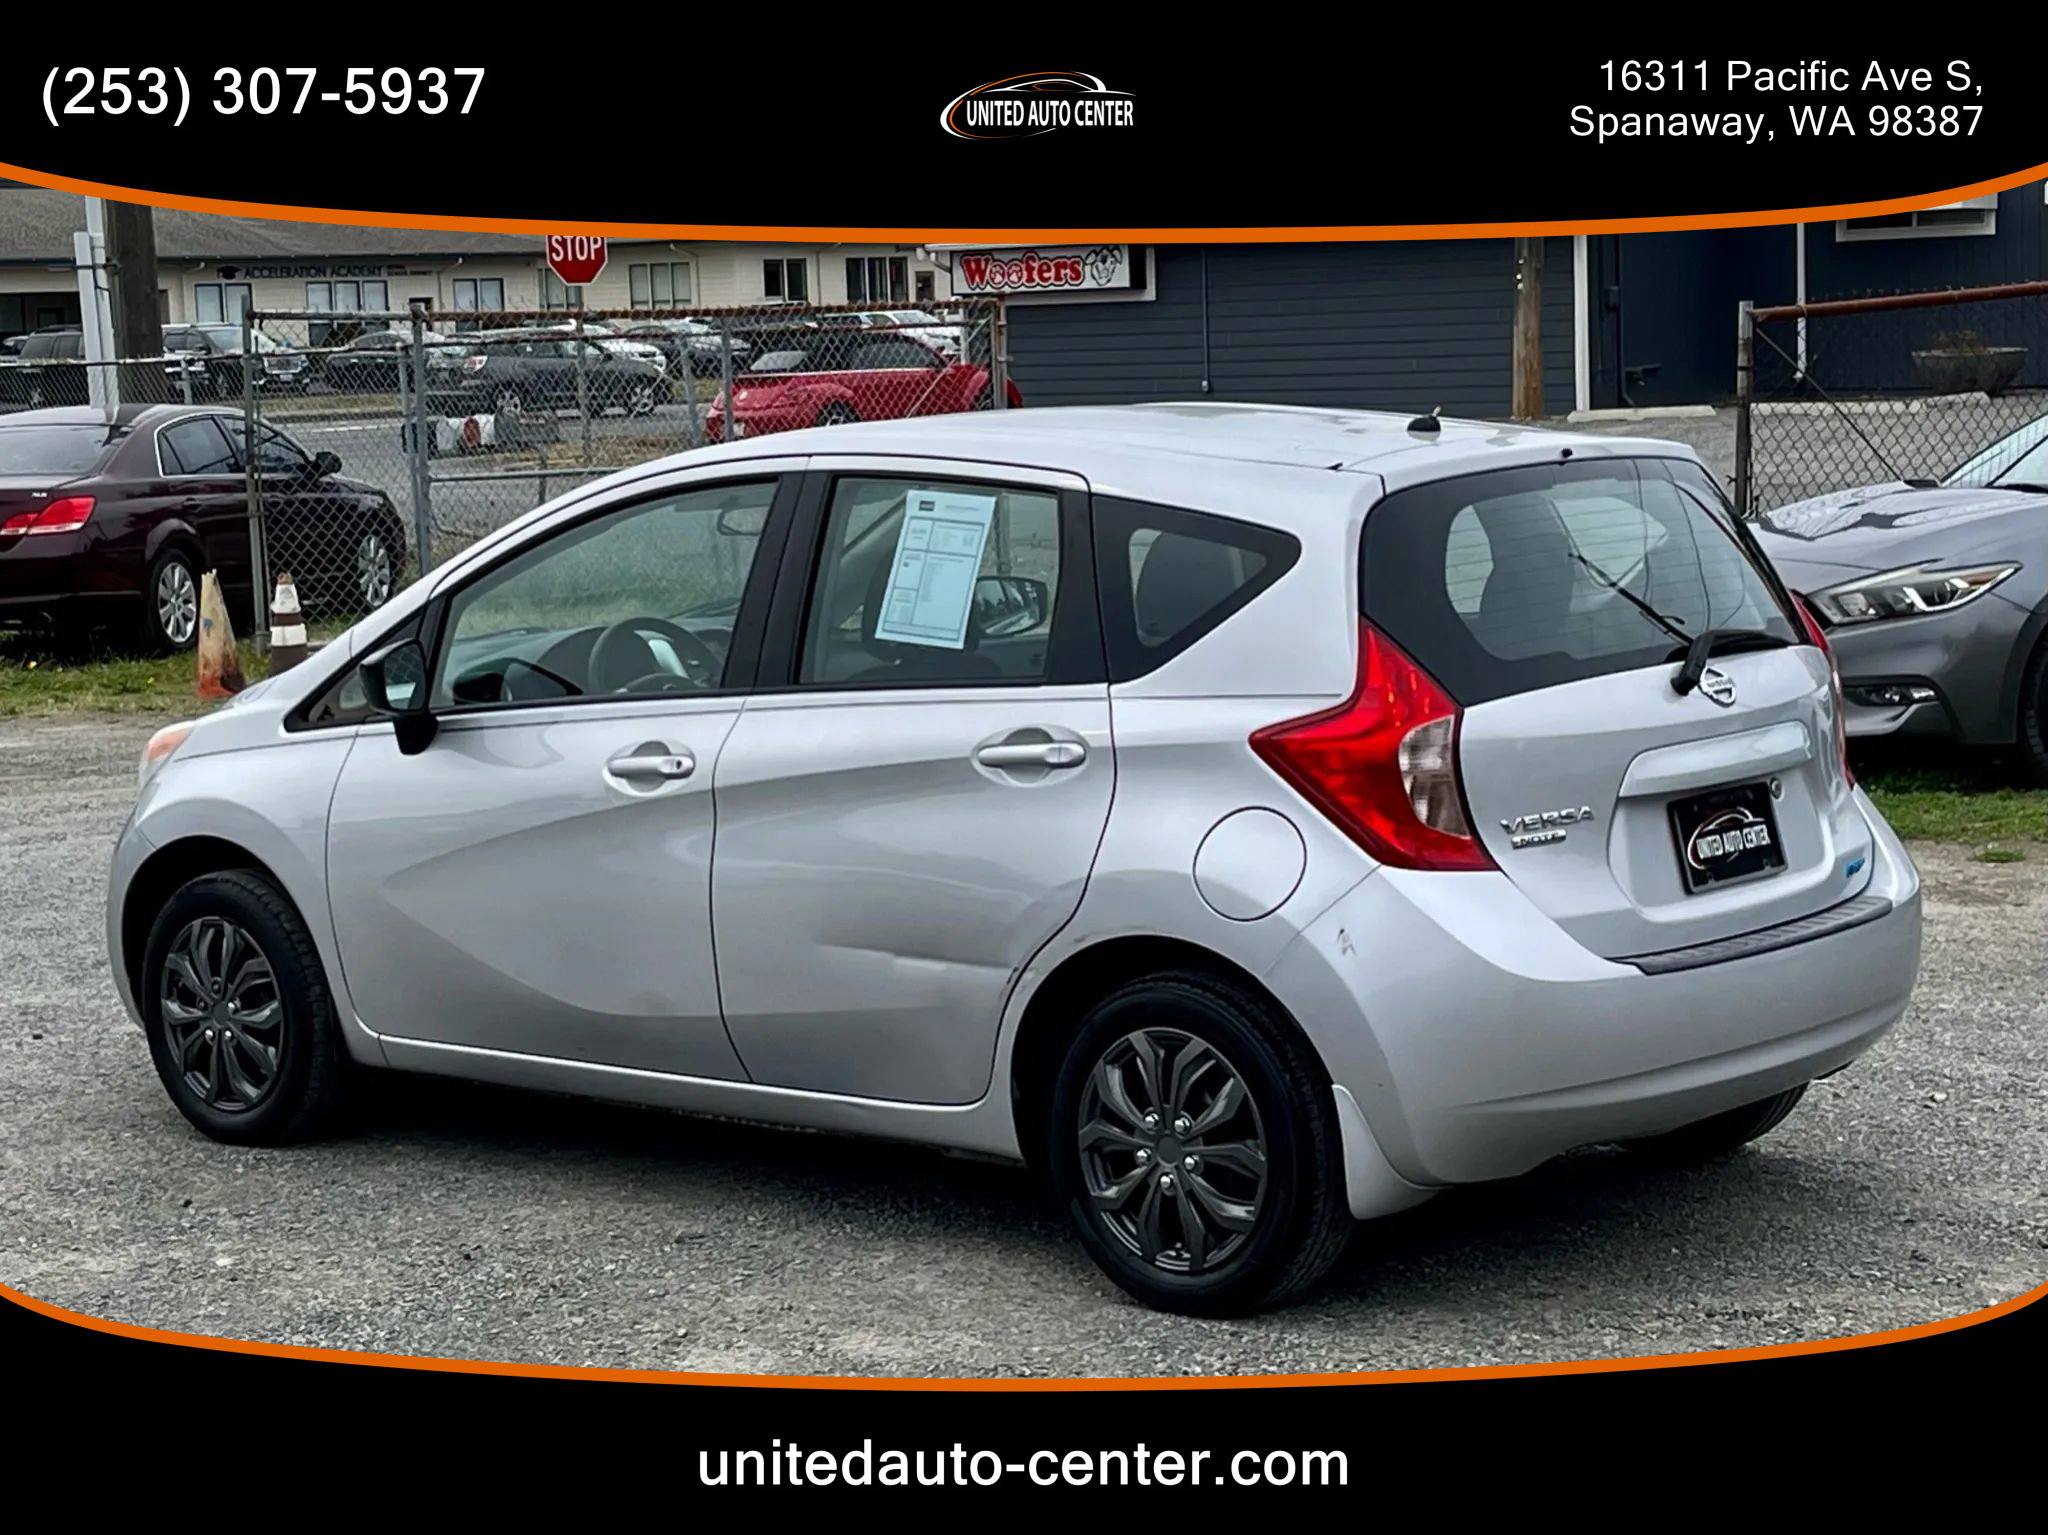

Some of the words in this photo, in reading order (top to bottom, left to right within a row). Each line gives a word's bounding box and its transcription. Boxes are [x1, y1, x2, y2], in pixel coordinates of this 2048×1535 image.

[551, 235, 602, 261] STOP
[243, 264, 326, 279] ACCELERATION
[330, 264, 383, 277] ACADEMY
[961, 251, 1084, 290] Woofers
[1499, 805, 1595, 834] VERSA
[1696, 834, 1723, 859] UNITED
[1723, 830, 1743, 853] AUTO
[1742, 824, 1770, 849] CENTER
